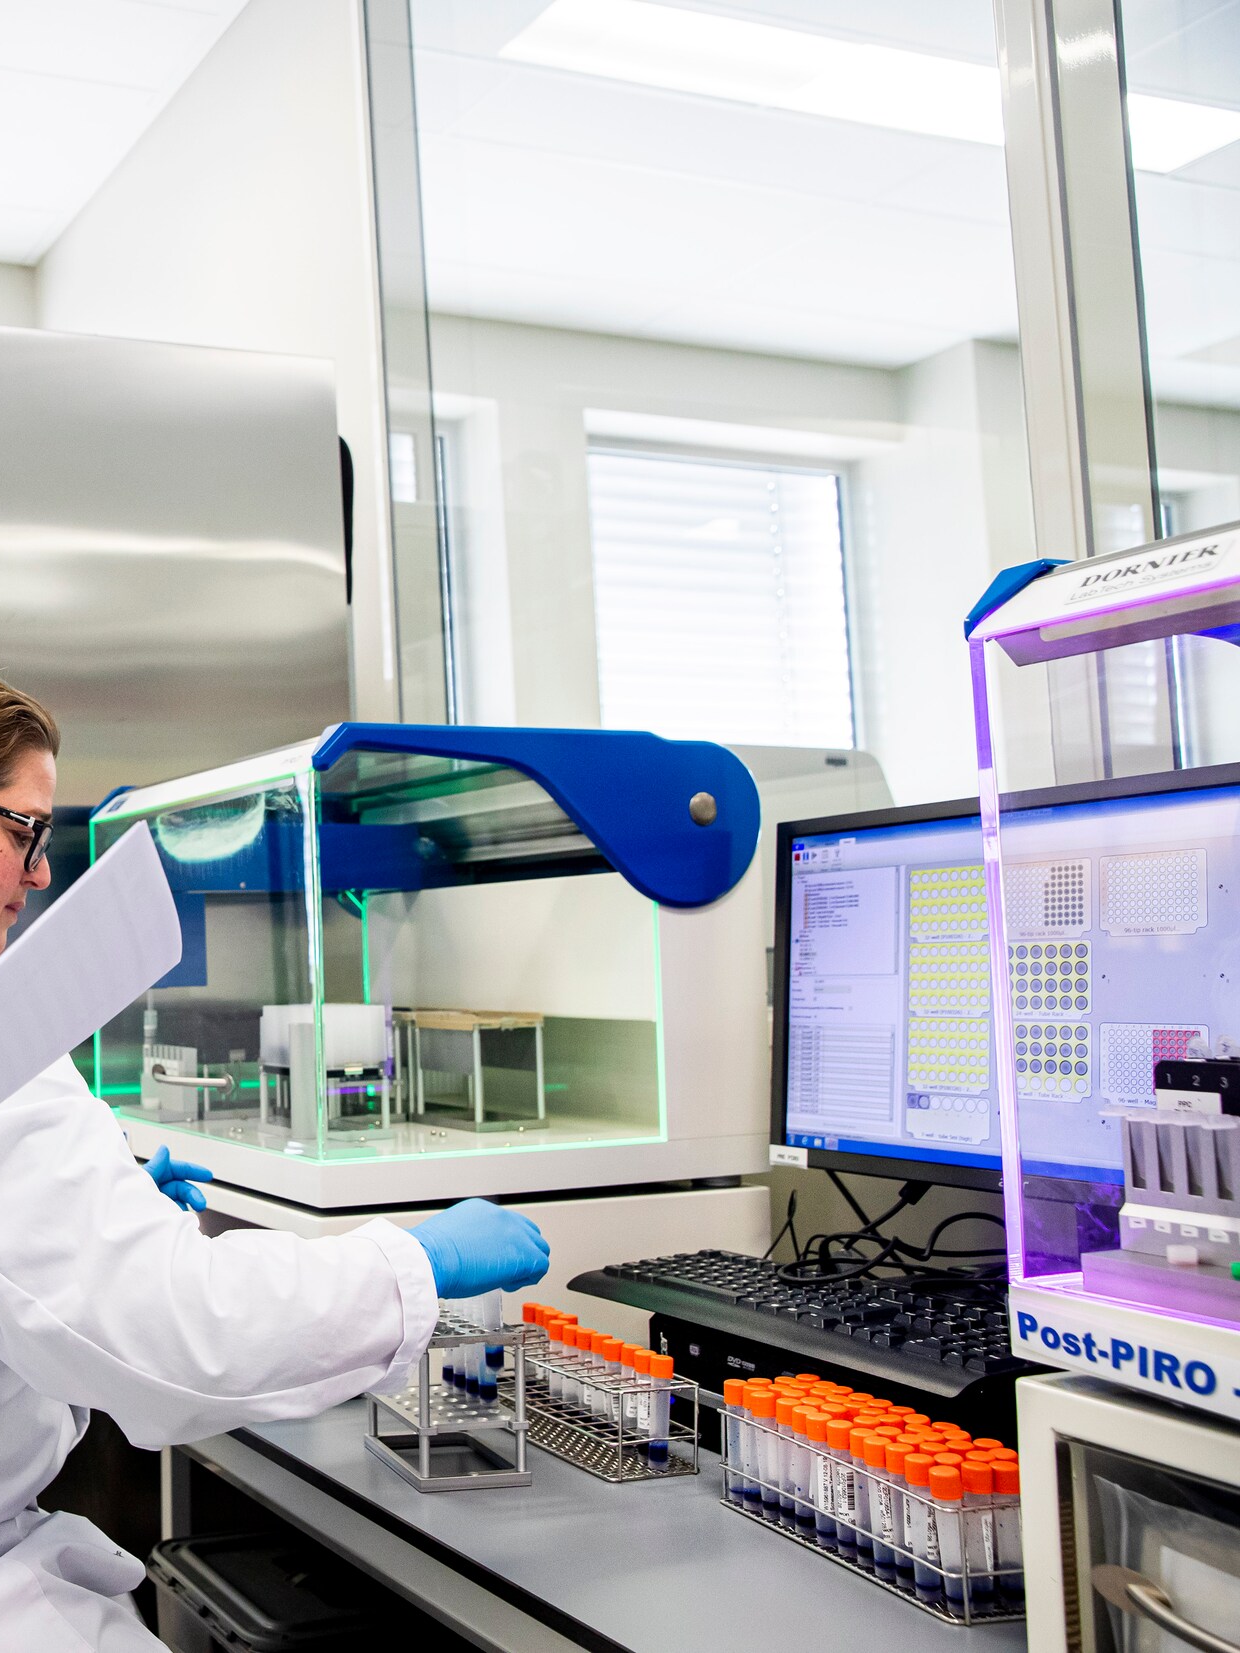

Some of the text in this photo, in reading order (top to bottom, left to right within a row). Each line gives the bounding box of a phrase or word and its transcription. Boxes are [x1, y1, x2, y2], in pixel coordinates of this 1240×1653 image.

[1080, 544, 1220, 588] DORNIER
[1166, 1072, 1172, 1085] 1
[1192, 1074, 1201, 1087] 2
[1220, 1076, 1229, 1089] 3
[1016, 1310, 1218, 1396] Post-PIRO
